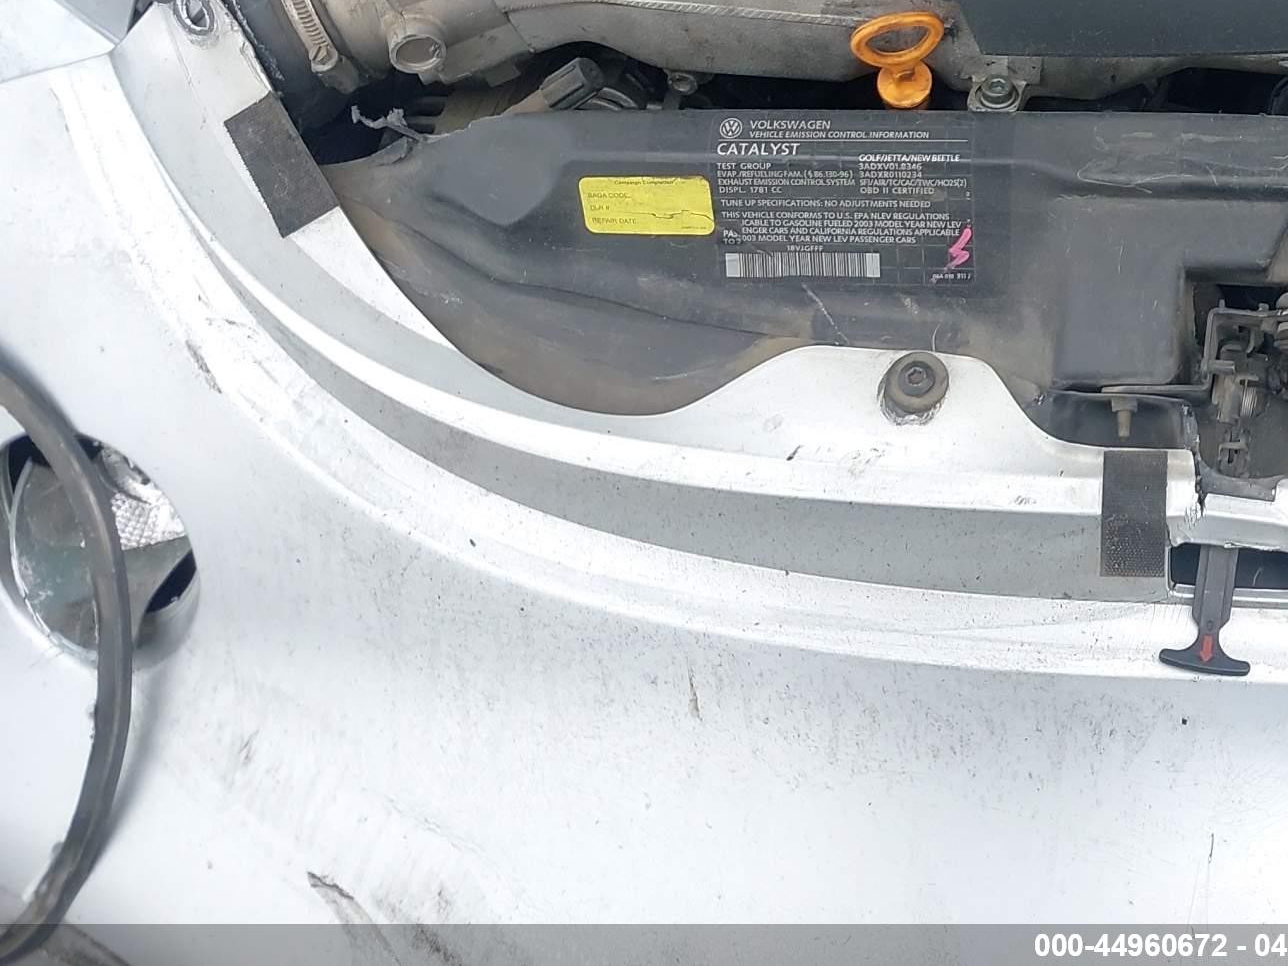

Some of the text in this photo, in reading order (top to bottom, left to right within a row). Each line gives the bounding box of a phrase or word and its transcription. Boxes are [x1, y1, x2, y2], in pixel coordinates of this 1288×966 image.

[750, 120, 831, 130] VOLKSWAGEN
[749, 131, 930, 139] VEHICLE EMISSION CONTROL INFORMATION
[717, 143, 801, 155] CATALYST
[932, 154, 960, 162] BEETLE
[860, 187, 879, 195] OBD
[892, 187, 935, 195] CERTIFIED
[875, 220, 904, 228] MODEL
[812, 235, 831, 243] NEW
